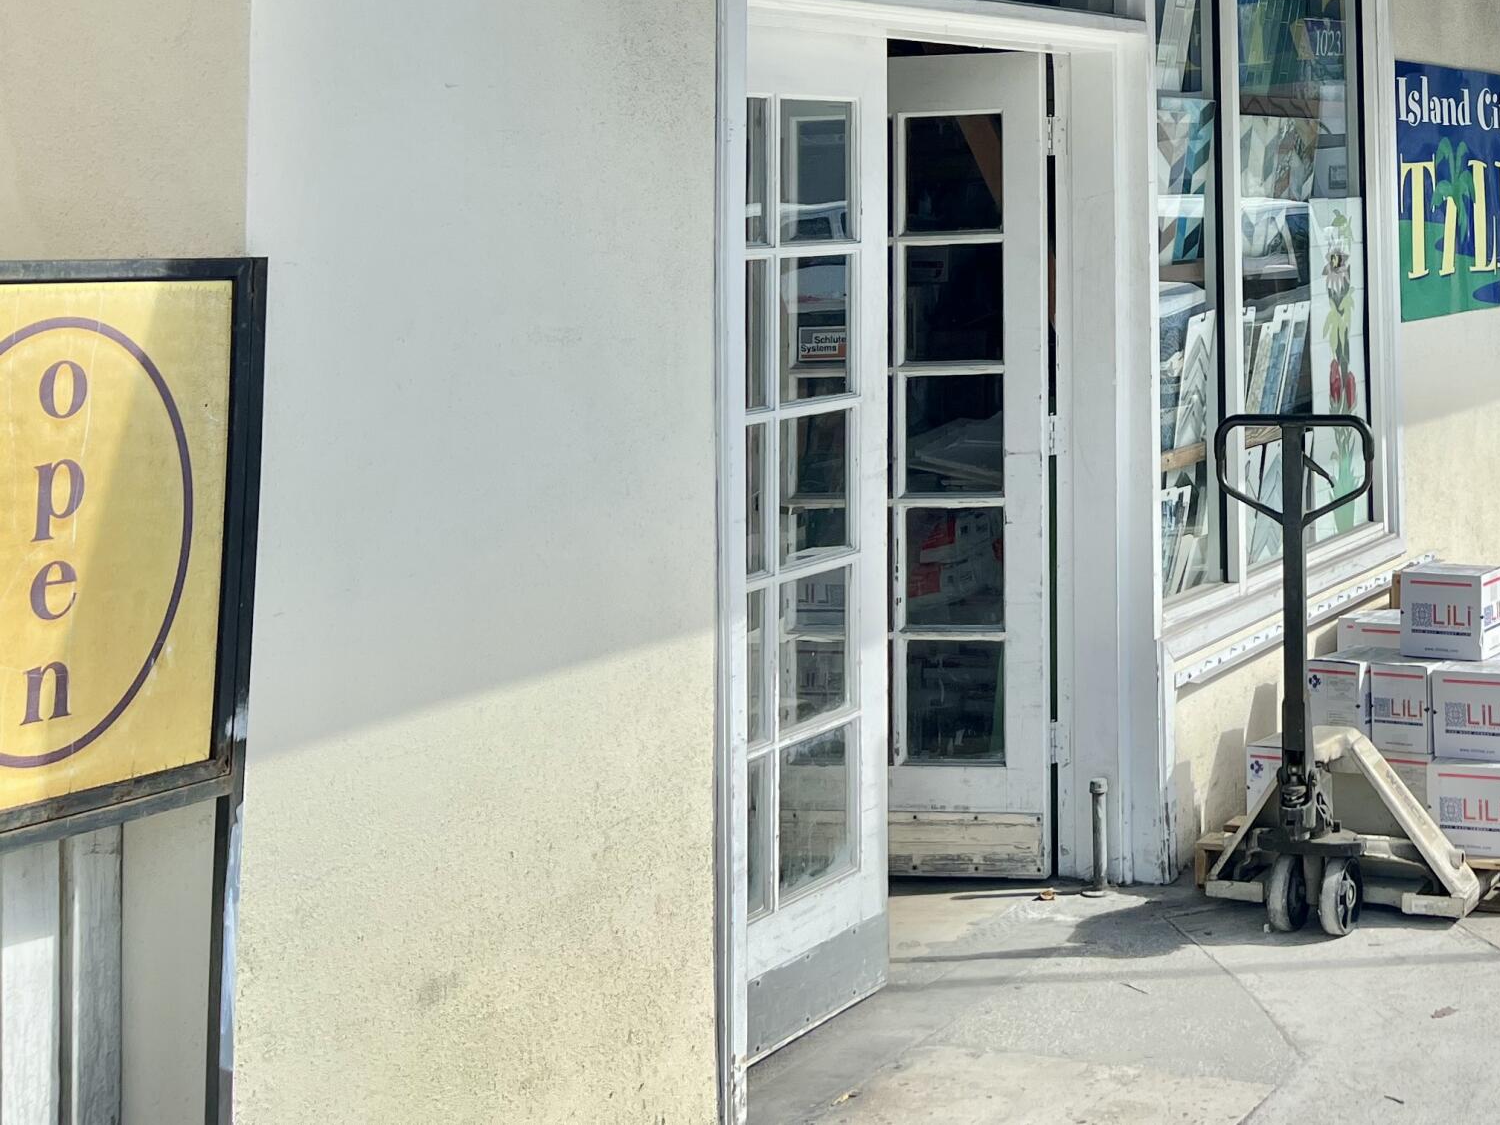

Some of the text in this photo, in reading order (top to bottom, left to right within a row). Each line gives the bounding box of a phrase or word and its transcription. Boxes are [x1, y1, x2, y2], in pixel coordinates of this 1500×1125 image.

[1315, 29, 1342, 56] 1023
[1396, 77, 1473, 128] Island
[801, 344, 837, 353] Systems
[19, 359, 89, 727] open
